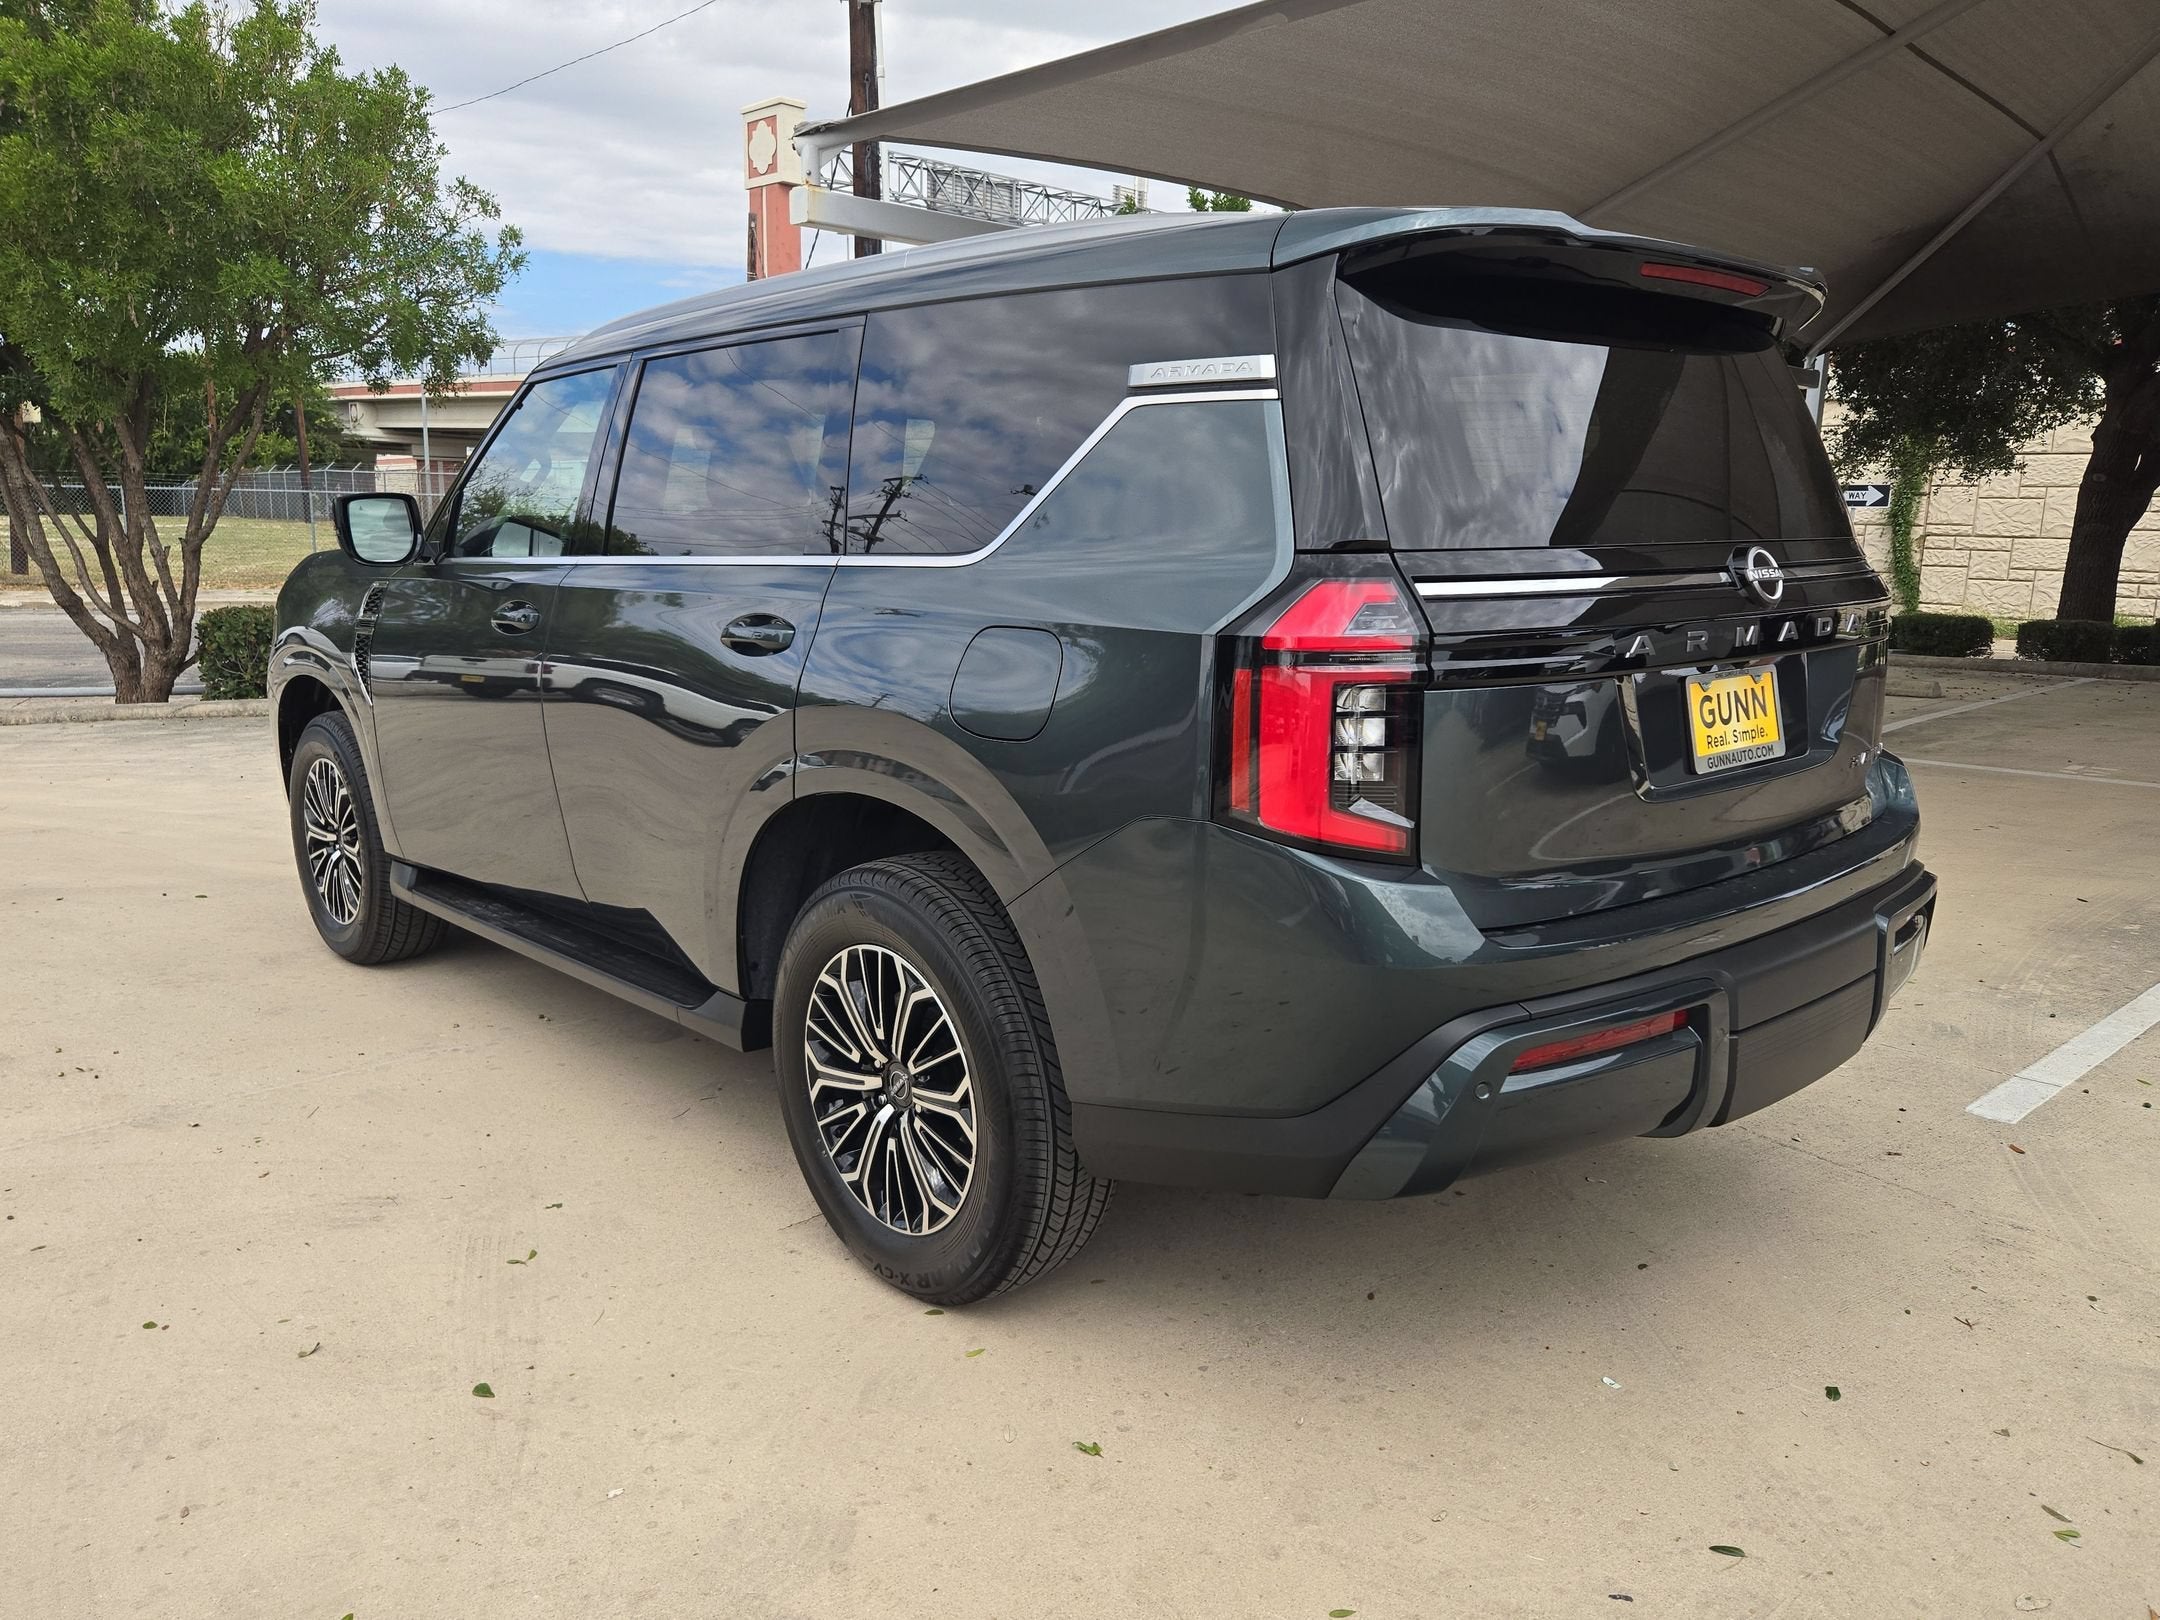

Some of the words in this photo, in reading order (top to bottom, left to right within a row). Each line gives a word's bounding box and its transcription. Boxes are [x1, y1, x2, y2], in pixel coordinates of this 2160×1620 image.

[1150, 361, 1253, 379] ARMADA
[1848, 491, 1867, 500] WAY
[1625, 613, 1862, 659] ARMADA
[1700, 685, 1768, 729] GUNN
[1706, 731, 1731, 749] Real.
[1707, 744, 1775, 769] GUNNAUTO.COM
